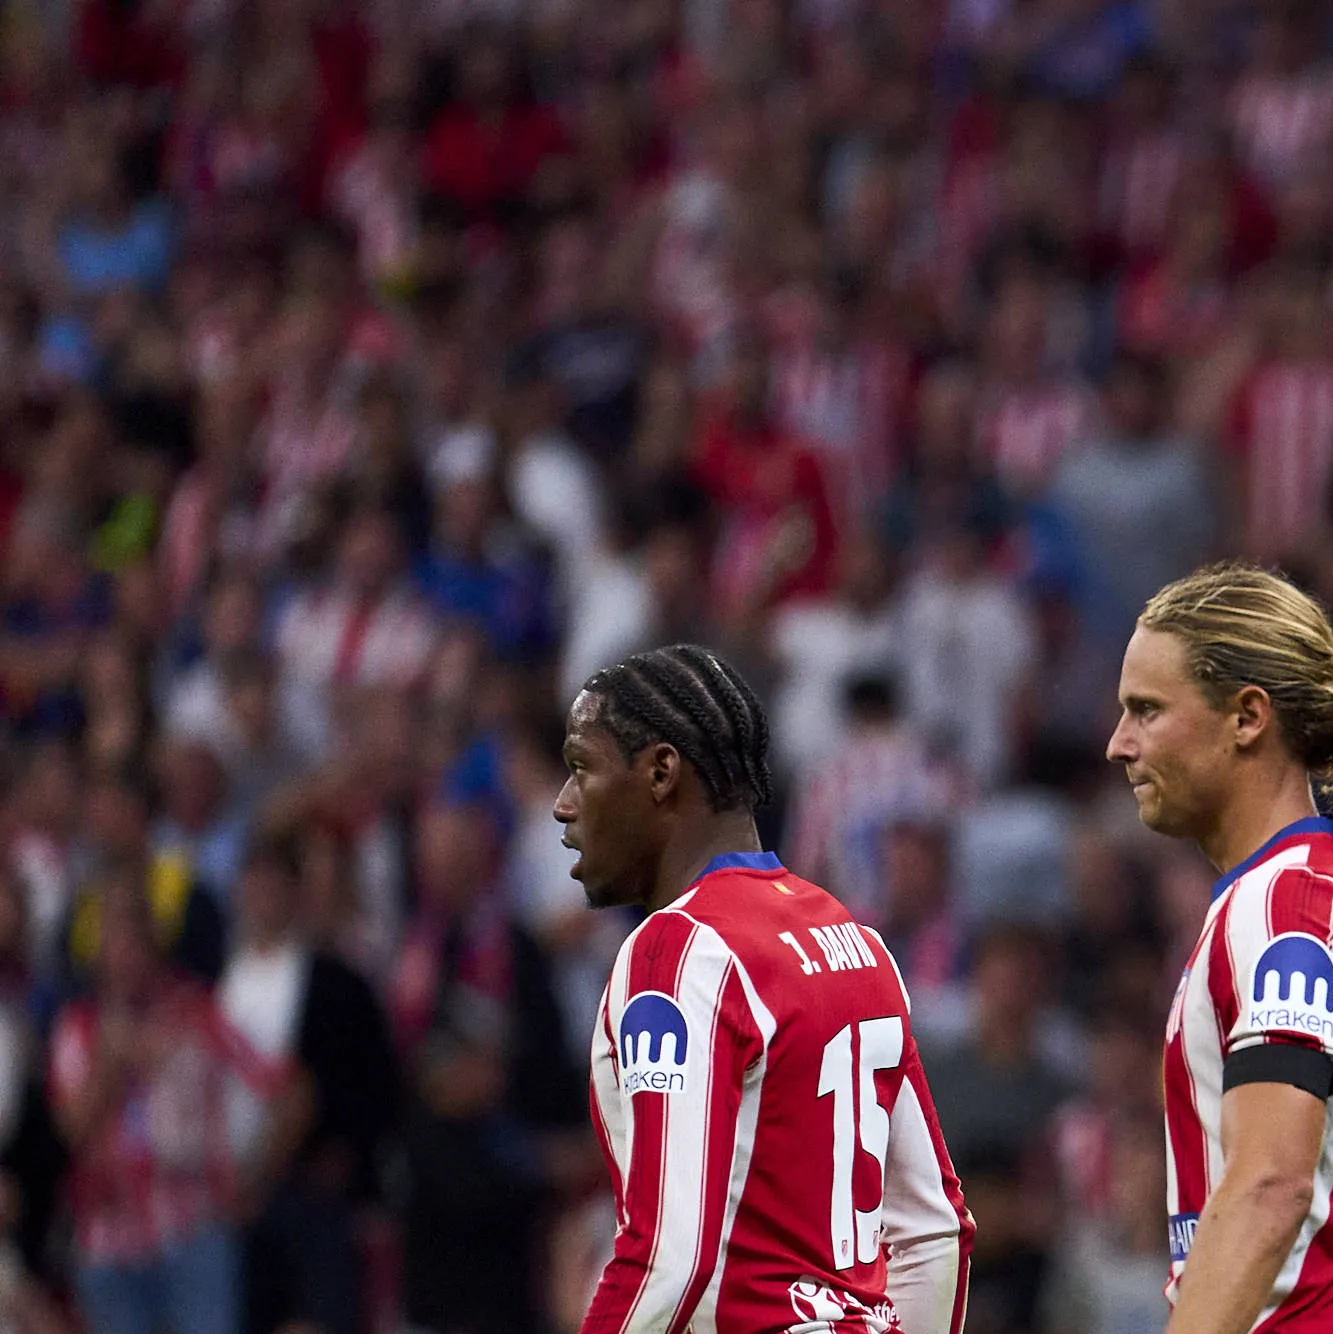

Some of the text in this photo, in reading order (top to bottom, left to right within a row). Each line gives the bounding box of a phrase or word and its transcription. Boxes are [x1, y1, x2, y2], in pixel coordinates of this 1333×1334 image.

[778, 931, 822, 976] J.
[1250, 1008, 1333, 1038] kraken
[816, 1015, 906, 1272] 15
